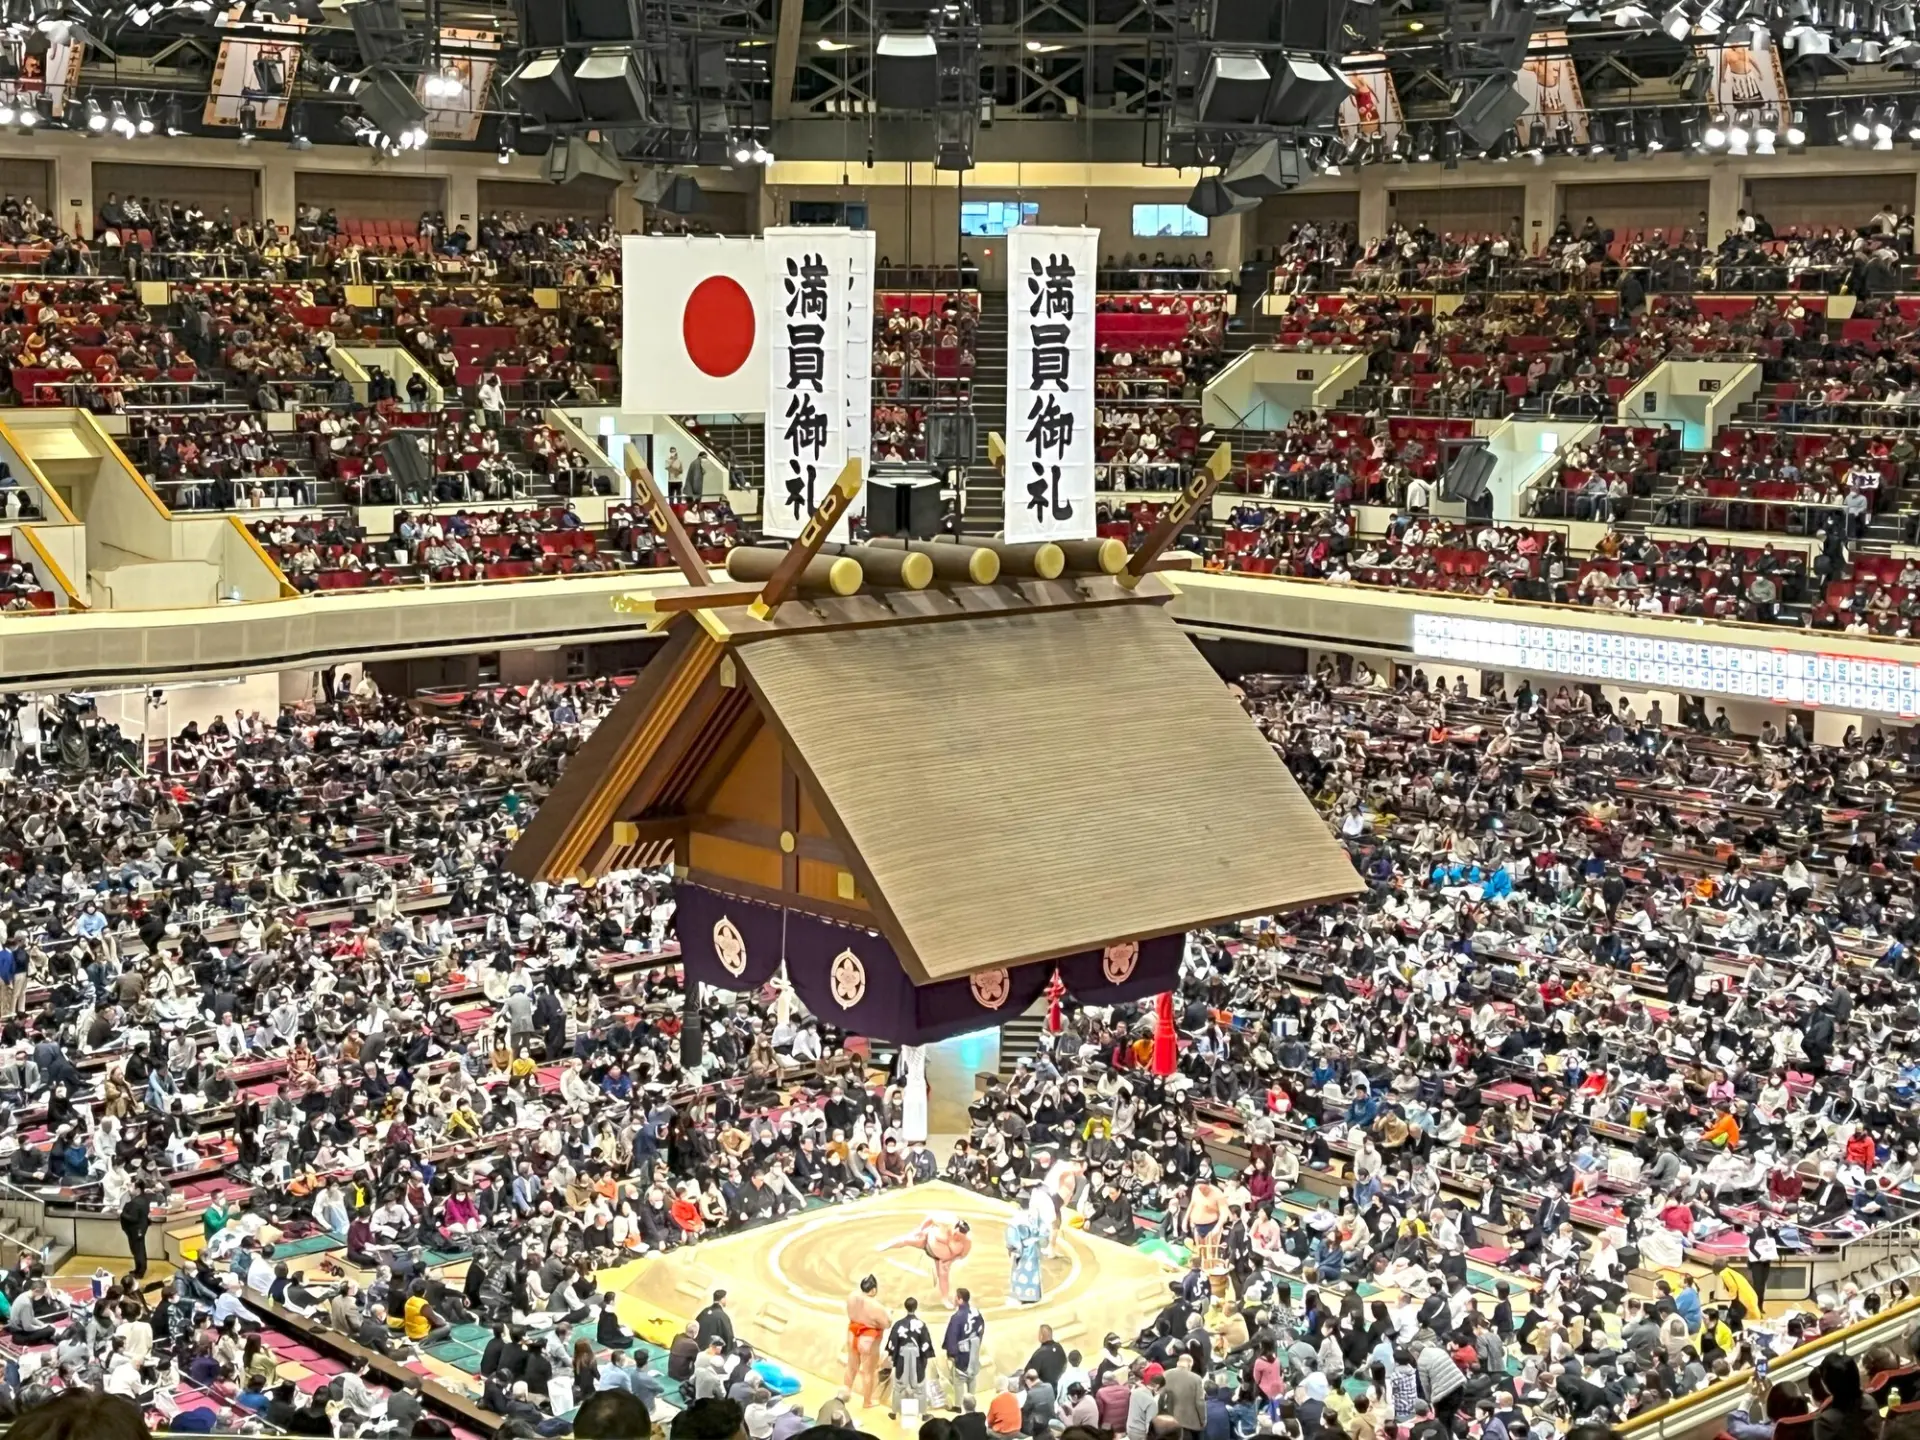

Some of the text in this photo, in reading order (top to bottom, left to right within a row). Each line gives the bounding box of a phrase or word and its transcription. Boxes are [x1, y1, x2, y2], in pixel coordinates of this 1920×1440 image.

[784, 253, 828, 520] 満員御礼
[1027, 253, 1075, 523] 満員御礼
